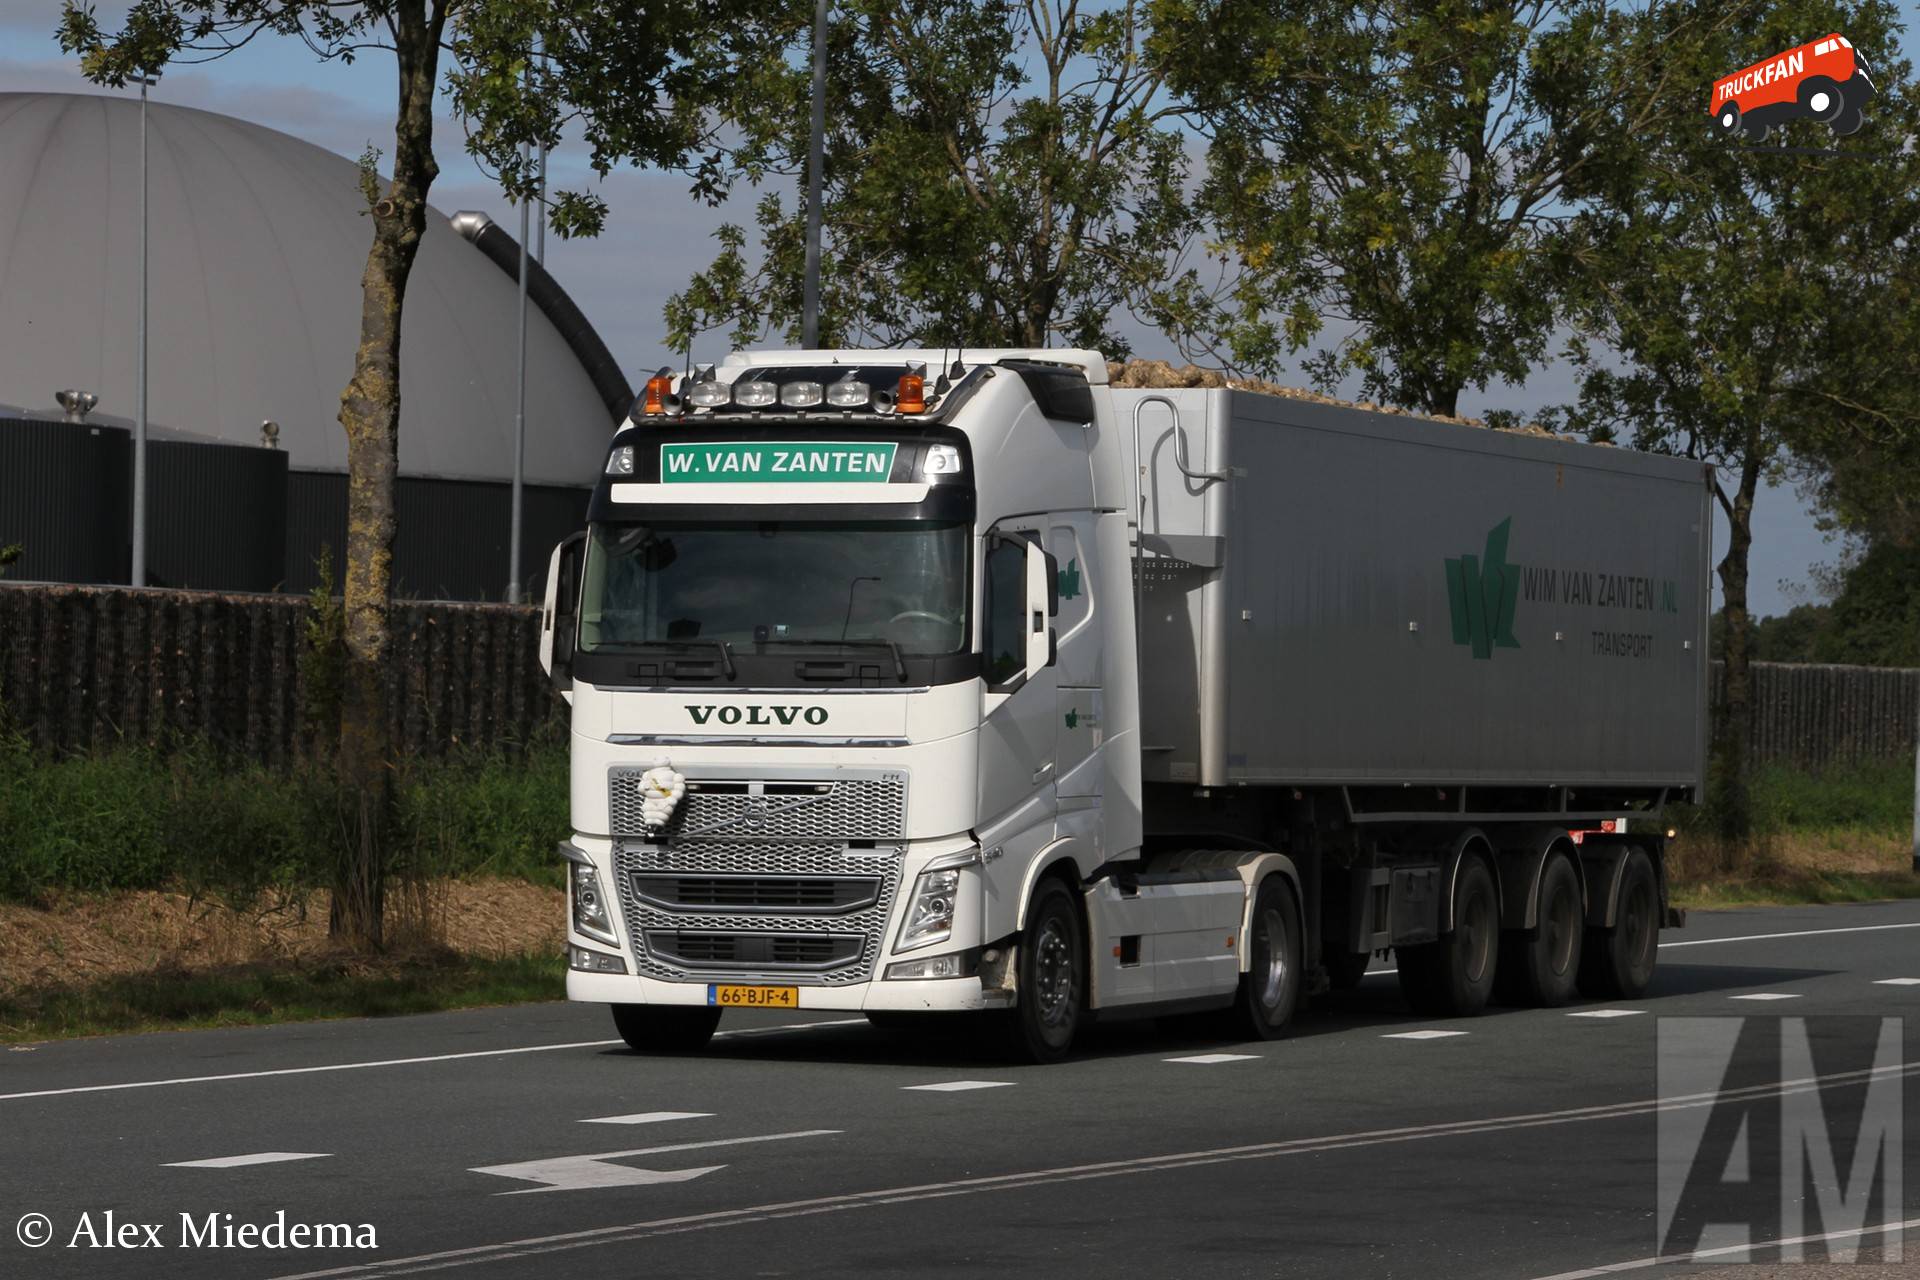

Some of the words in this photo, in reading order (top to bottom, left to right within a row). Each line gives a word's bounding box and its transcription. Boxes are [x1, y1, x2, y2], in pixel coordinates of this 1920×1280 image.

[771, 452, 886, 473] ZANTEN
[1523, 567, 1557, 602] WIM
[1562, 570, 1593, 606] VAN
[1599, 574, 1653, 611] ZANTEN
[1592, 631, 1653, 659] TRANSPORT
[684, 705, 829, 726] VOLVO
